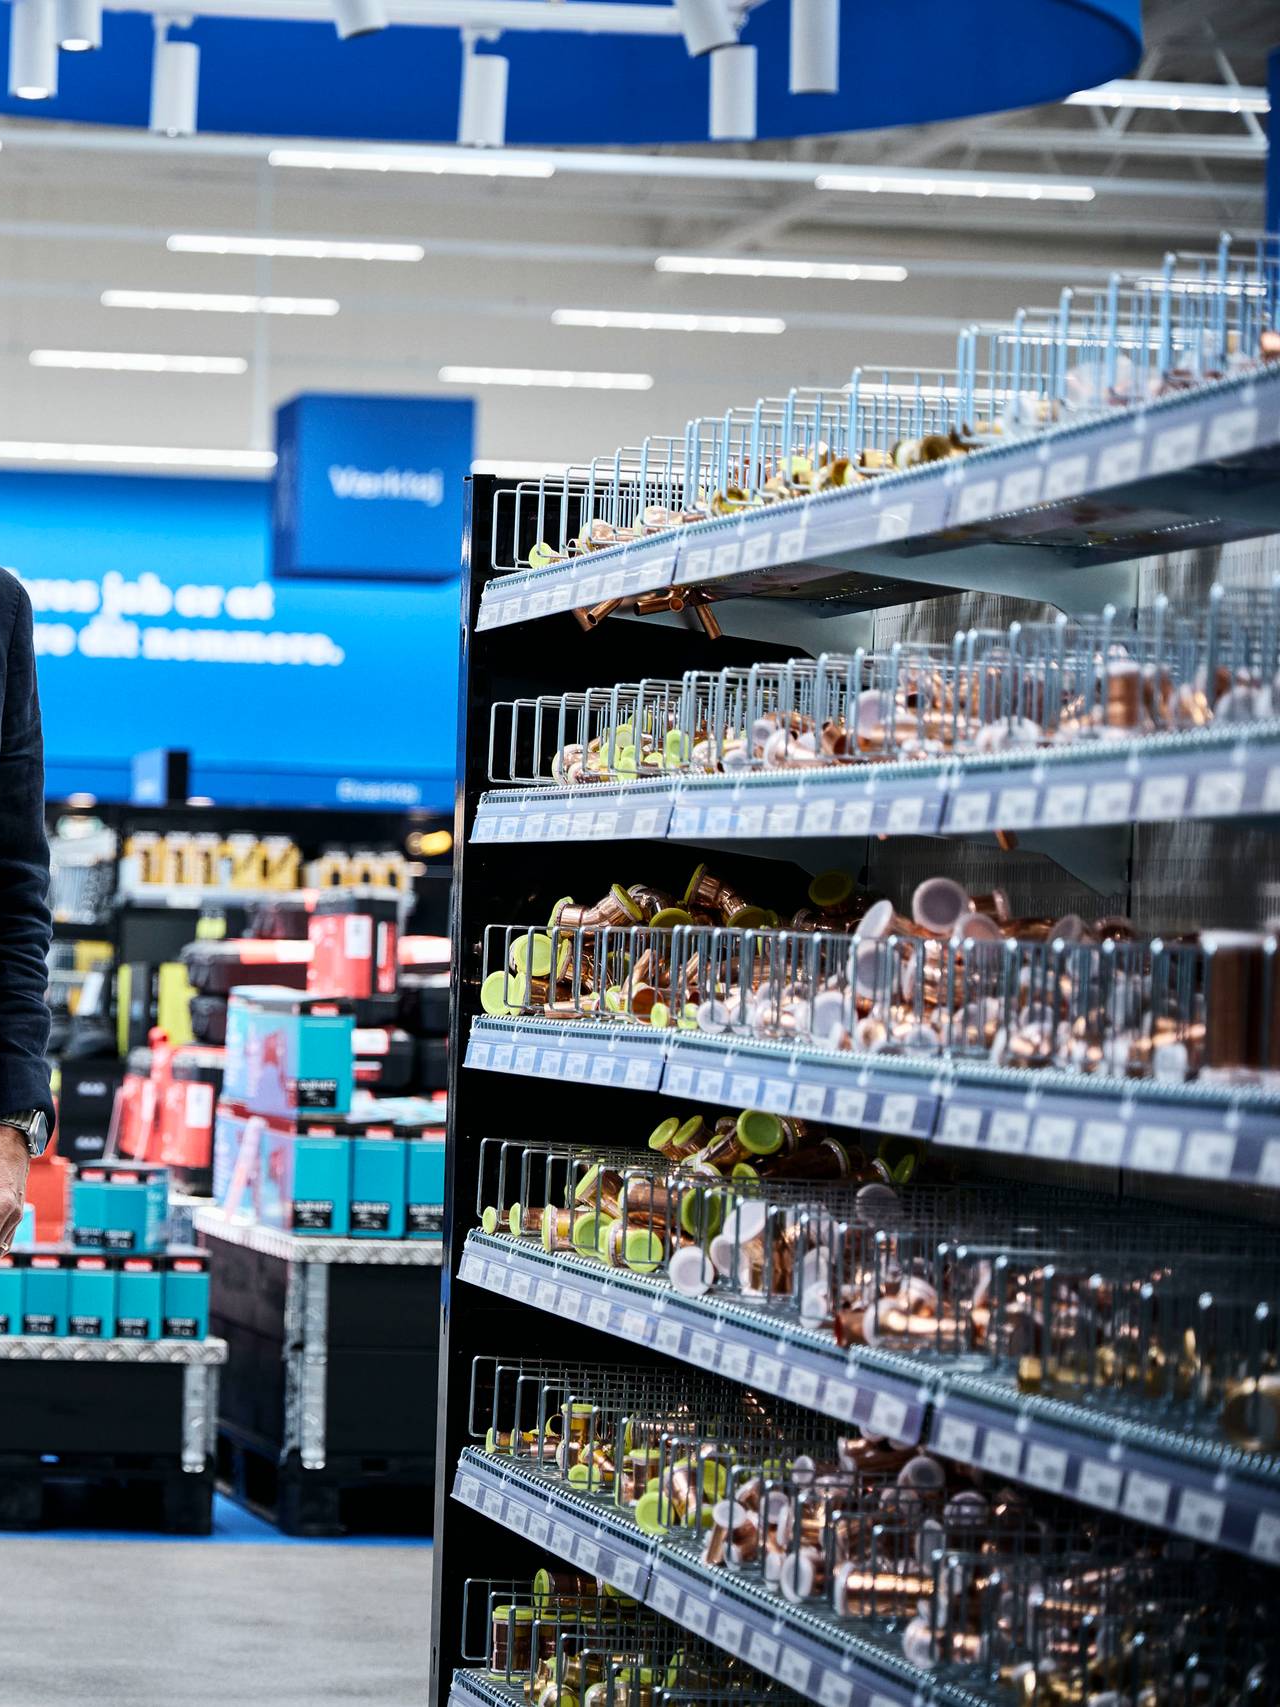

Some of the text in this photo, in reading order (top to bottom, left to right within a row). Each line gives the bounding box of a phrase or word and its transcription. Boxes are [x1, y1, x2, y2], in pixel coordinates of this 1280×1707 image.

[101, 570, 173, 618] job
[174, 584, 224, 619] er
[225, 581, 276, 621] at
